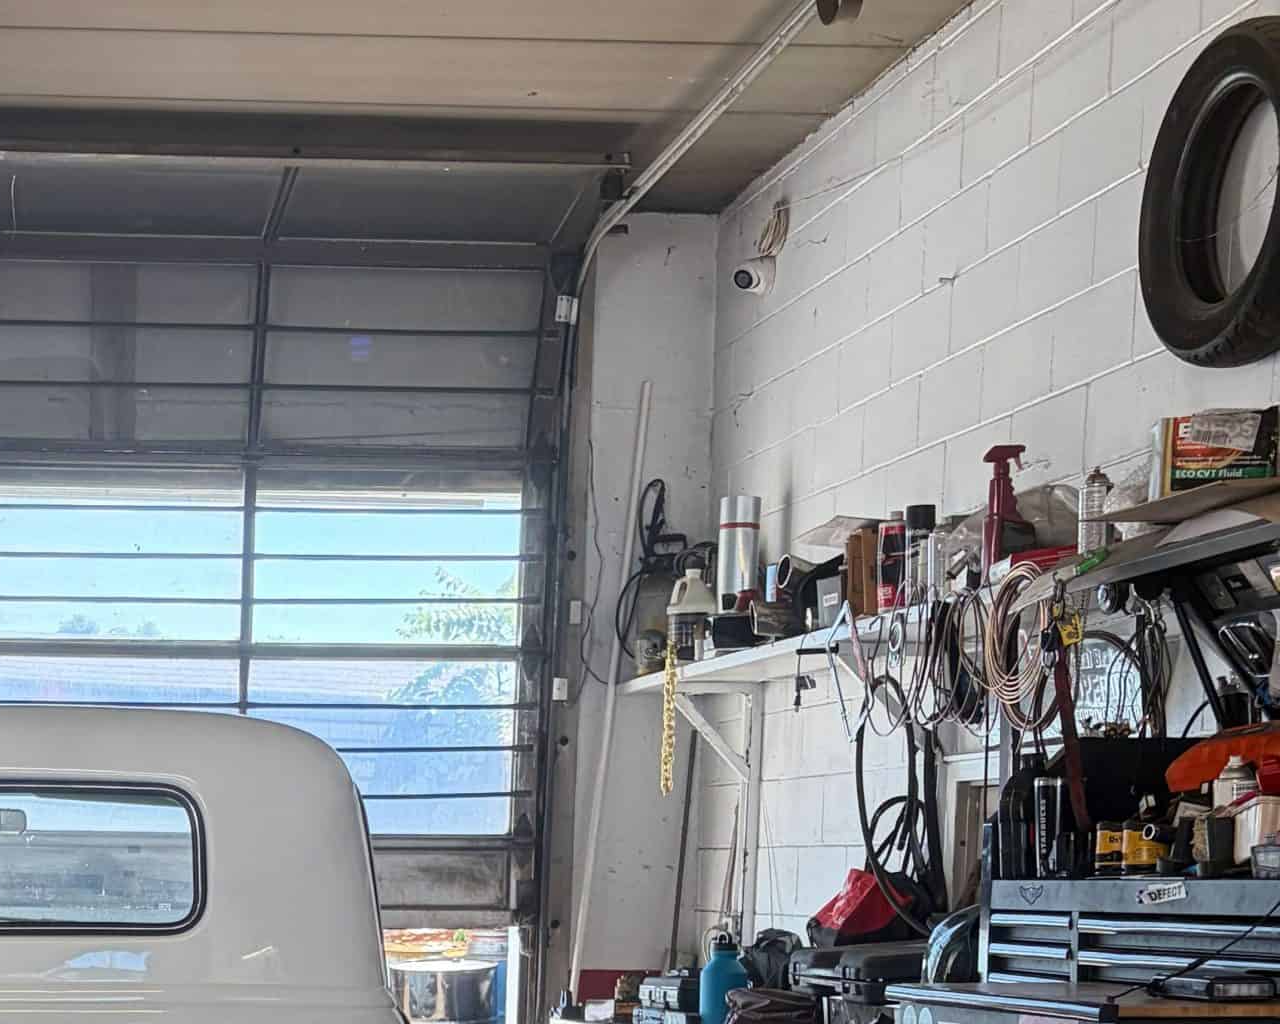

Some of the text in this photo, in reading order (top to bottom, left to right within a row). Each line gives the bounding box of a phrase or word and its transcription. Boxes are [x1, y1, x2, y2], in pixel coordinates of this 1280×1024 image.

[1175, 468, 1243, 479] ECO CVT Fluid
[1038, 799, 1047, 854] STARBUCKS
[1147, 884, 1183, 902] DEFECT
